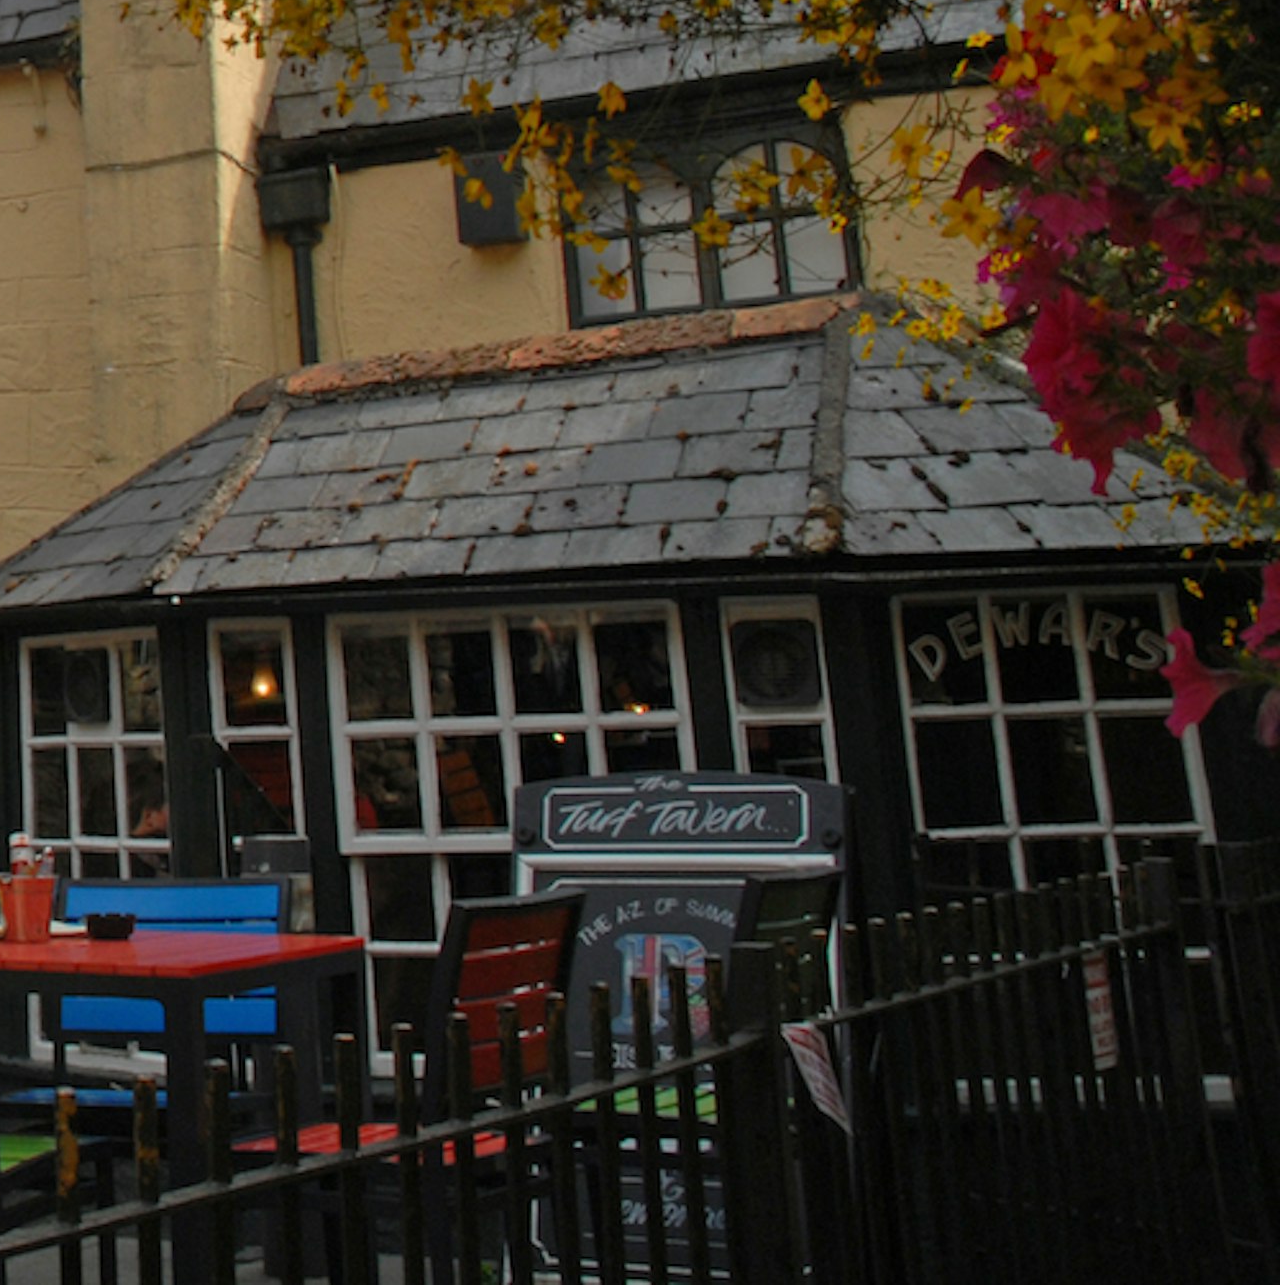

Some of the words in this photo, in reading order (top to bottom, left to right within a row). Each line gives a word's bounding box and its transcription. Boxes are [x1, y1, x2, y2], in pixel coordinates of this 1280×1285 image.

[908, 600, 1167, 683] DEWAR'S
[634, 775, 684, 792] The
[558, 799, 644, 838] Turf
[577, 912, 613, 947] THE
